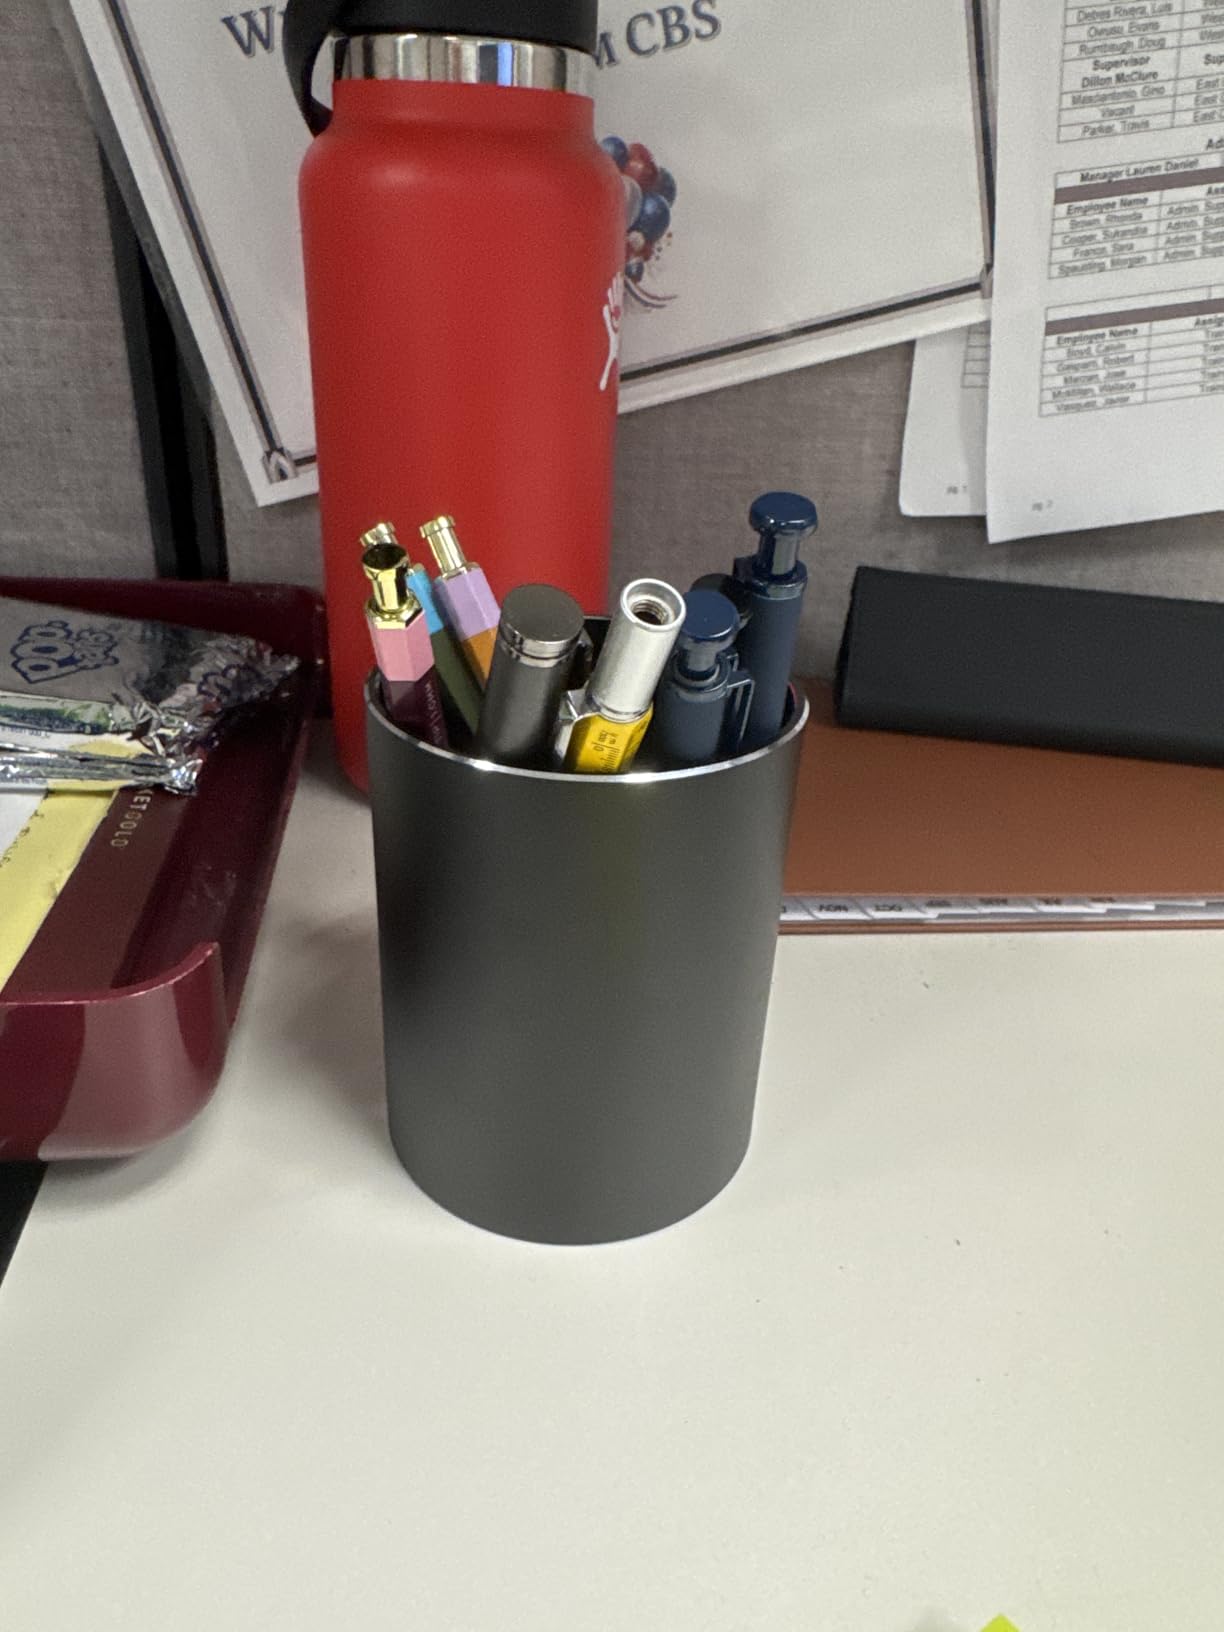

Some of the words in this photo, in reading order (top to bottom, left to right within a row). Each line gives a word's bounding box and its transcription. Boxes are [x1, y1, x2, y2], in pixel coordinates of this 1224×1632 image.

[626, 0, 721, 57] CBS
[1092, 56, 1150, 71] Supervisor
[1080, 169, 1124, 184] Manager
[1066, 201, 1117, 216] Employee
[1120, 197, 1149, 208] Name
[1056, 331, 1106, 346] Employee
[1109, 327, 1139, 339] Name
